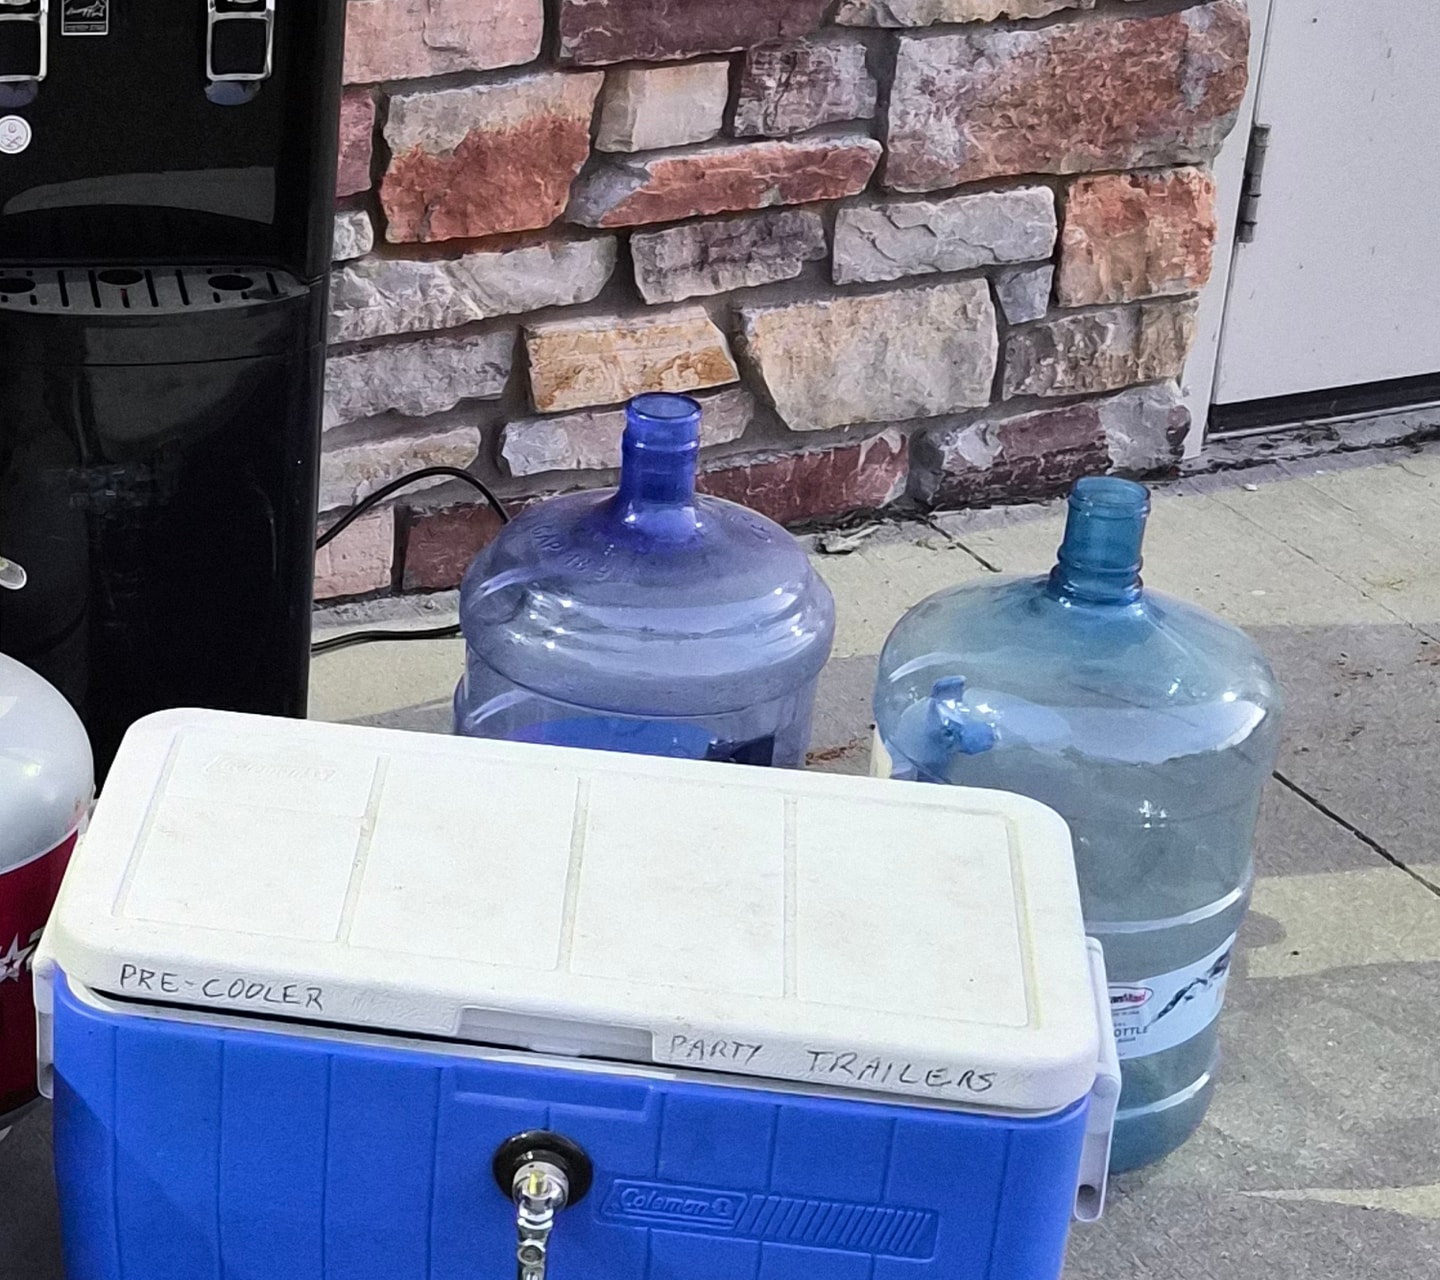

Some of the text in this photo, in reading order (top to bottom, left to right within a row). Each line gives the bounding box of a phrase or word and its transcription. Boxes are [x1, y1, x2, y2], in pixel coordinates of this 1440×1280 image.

[119, 963, 324, 1011] PRE-COOLER
[1113, 1026, 1148, 1038] OTTLE
[669, 1035, 996, 1093] PARTY TRAILERS
[621, 1188, 710, 1214] Coleman
